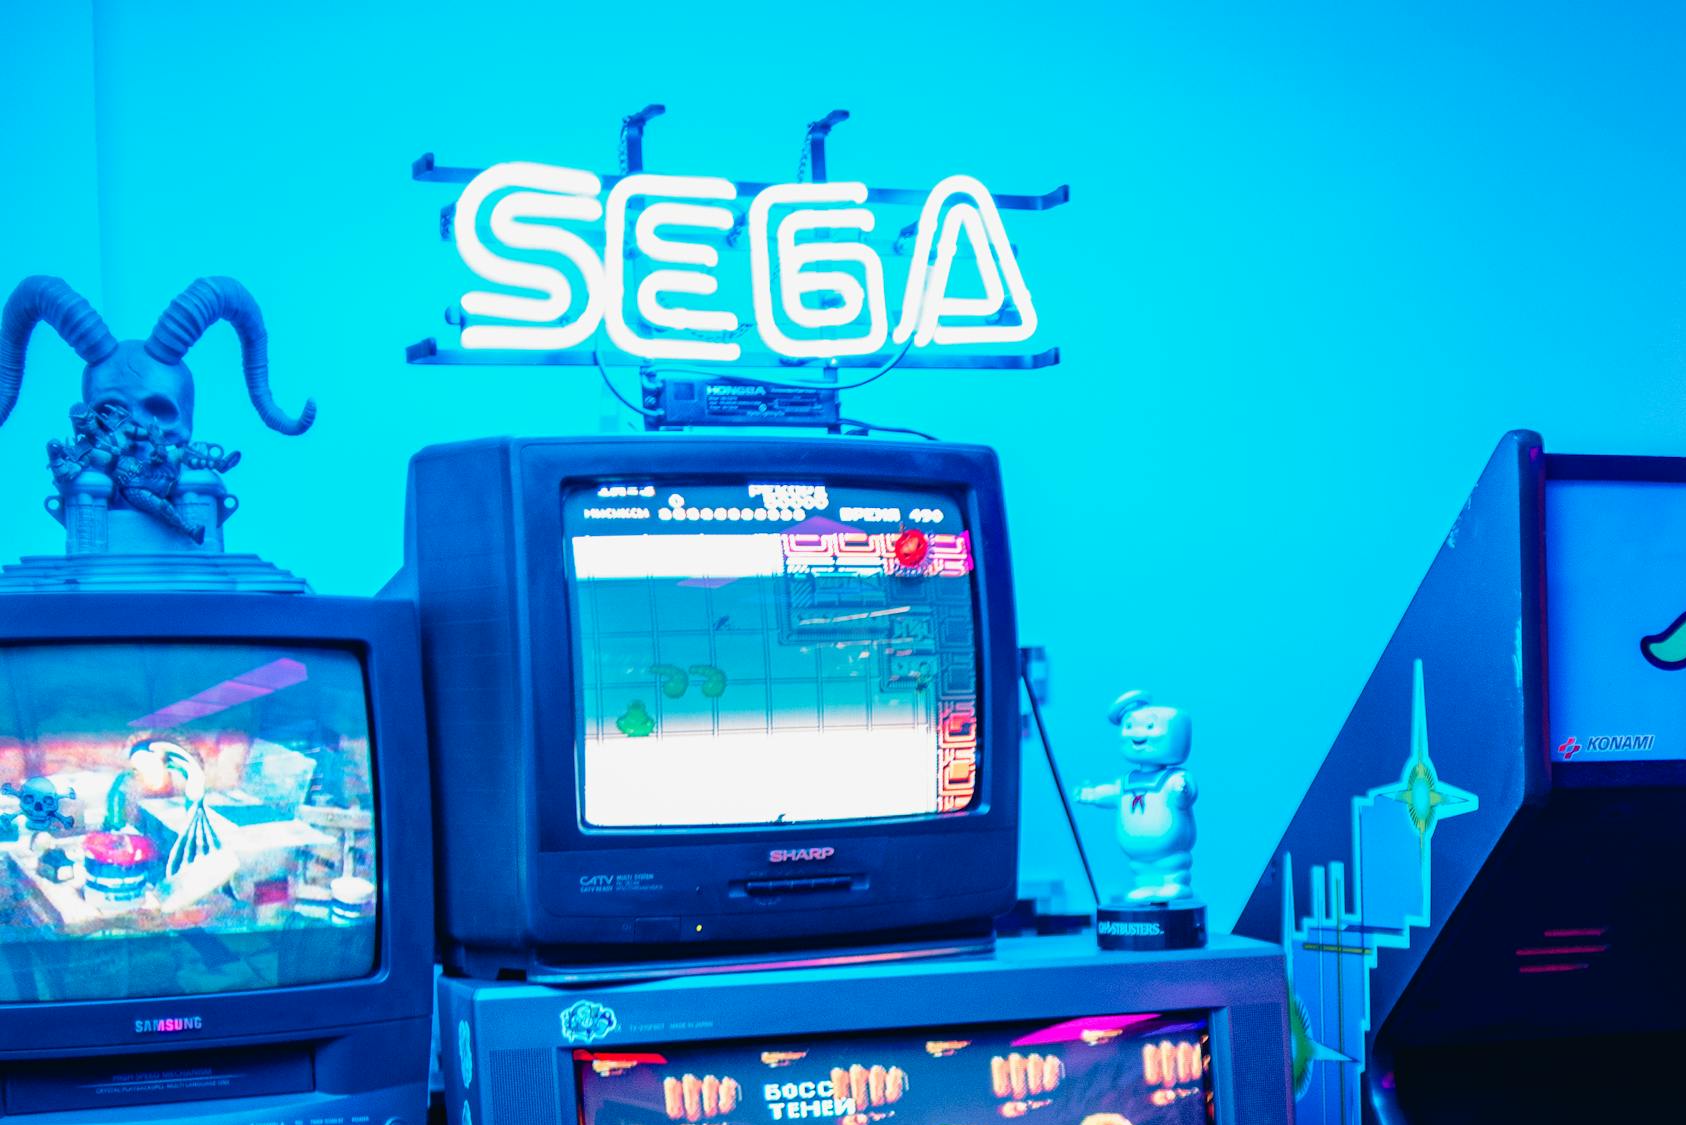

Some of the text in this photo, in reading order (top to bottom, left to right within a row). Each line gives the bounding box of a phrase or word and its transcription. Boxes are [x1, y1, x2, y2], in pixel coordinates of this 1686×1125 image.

[455, 161, 1037, 359] SEGA
[1585, 733, 1655, 753] KONAMI
[770, 847, 834, 862] SHARP
[135, 1016, 202, 1034] SAMSUNG
[764, 1080, 833, 1101] БОСС
[768, 1096, 856, 1121] ТЕНЕЙ
